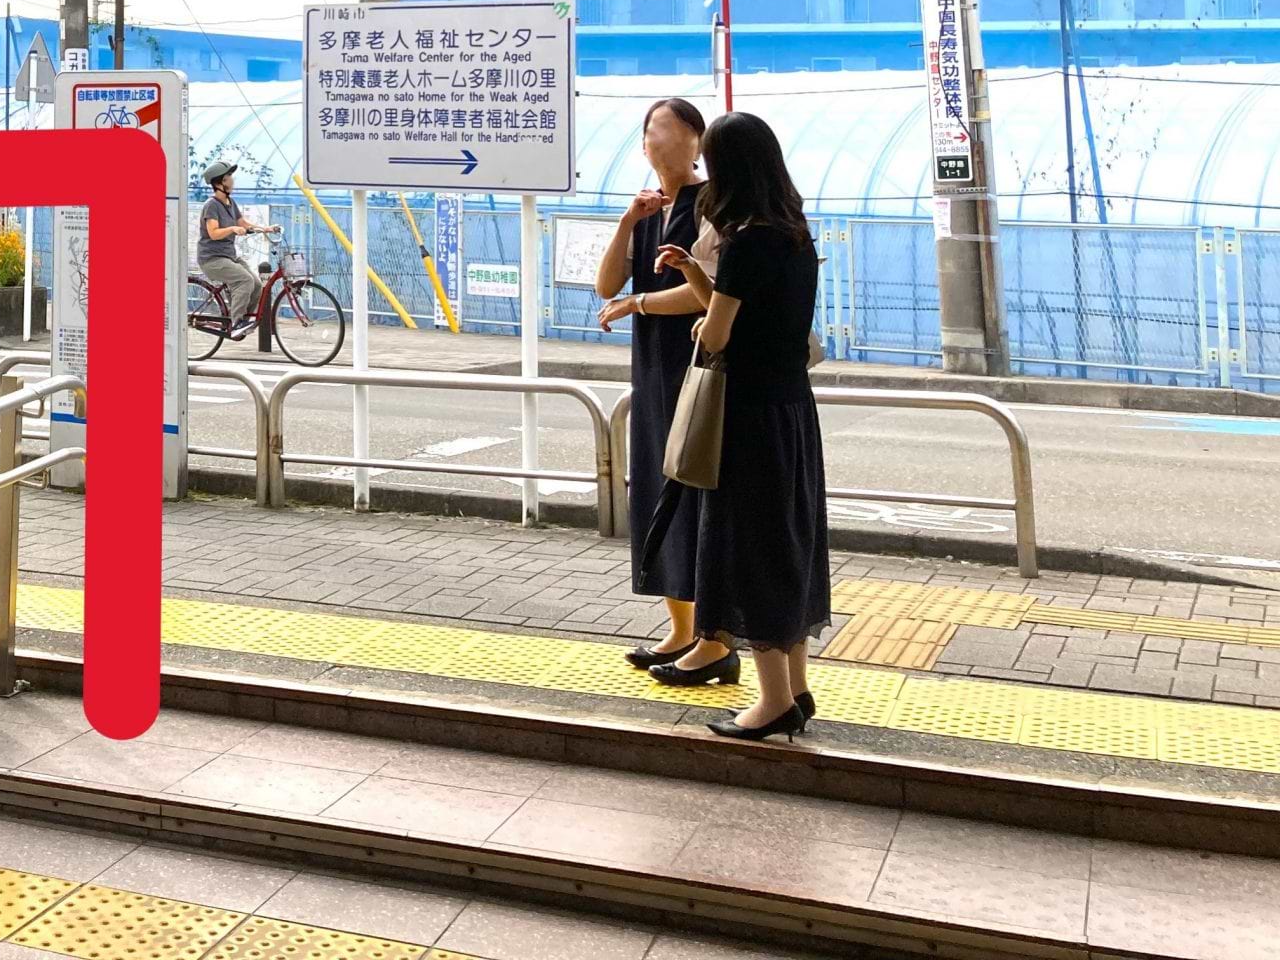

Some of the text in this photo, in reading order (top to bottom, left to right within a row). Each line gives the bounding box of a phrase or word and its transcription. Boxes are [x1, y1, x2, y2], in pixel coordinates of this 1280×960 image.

[323, 8, 366, 20] 川崎市
[318, 28, 557, 51] 多摩老人福祉センター
[341, 51, 532, 64] Tama Welfare Center for the Aged
[938, 0, 963, 118] 中国長寿気功整体院
[318, 68, 557, 89] 特別養護老人ホーム多摩川の里
[929, 41, 941, 119] 中野島センター
[77, 89, 155, 101] 自転車等放置禁止区域
[325, 91, 374, 104] Tamagawa
[394, 93, 414, 102] sato
[418, 91, 446, 102] Home
[451, 92, 465, 102] for
[469, 91, 485, 102] the
[489, 91, 518, 102] Weak
[523, 92, 550, 104] Aged
[318, 107, 557, 130] 多摩川の里身体障害者福祉会館
[321, 129, 366, 142] Tamagawa
[369, 132, 379, 140] no
[383, 130, 401, 140] sato
[405, 131, 438, 142] Welfare
[440, 131, 458, 141] Hall
[461, 131, 474, 141] for
[478, 132, 492, 142] the
[940, 160, 965, 168] 中野島
[945, 169, 961, 177] 1-1
[468, 269, 518, 284] 中野島幼稚園
